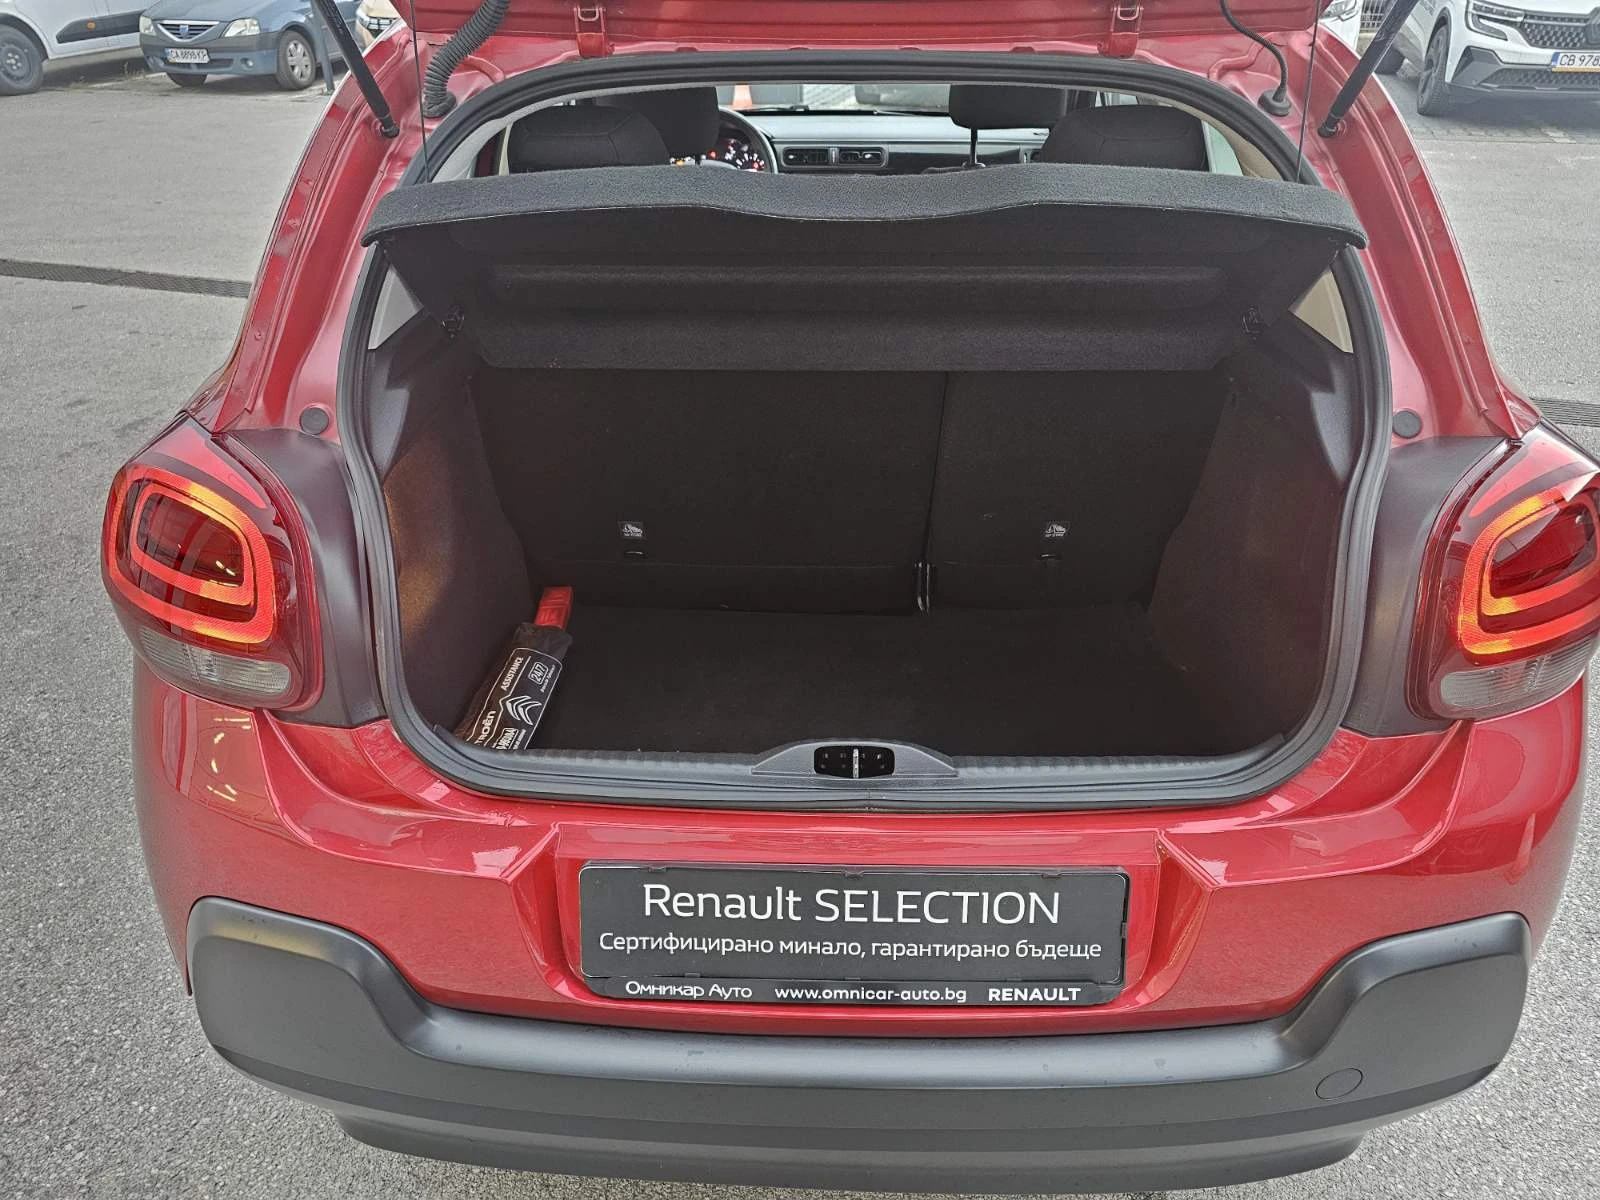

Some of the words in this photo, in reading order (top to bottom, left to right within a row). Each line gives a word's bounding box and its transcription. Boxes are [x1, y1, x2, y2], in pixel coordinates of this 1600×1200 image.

[1560, 54, 1576, 66] CB
[1579, 54, 1600, 67] 978
[500, 656, 524, 691] ASSISTANCE
[531, 664, 546, 683] 24/7
[643, 884, 802, 921] Renault
[815, 889, 1060, 925] SELECTION
[599, 932, 774, 955] Сертифицирано
[779, 939, 866, 959] минало,
[871, 942, 1010, 961] гарантирано
[1015, 939, 1102, 960] бъдеще
[625, 980, 705, 999] Омникар
[708, 983, 753, 1000] Ауто
[774, 987, 967, 1002] www.omnicar-auto.bg
[988, 987, 1081, 1001] RENAULT
